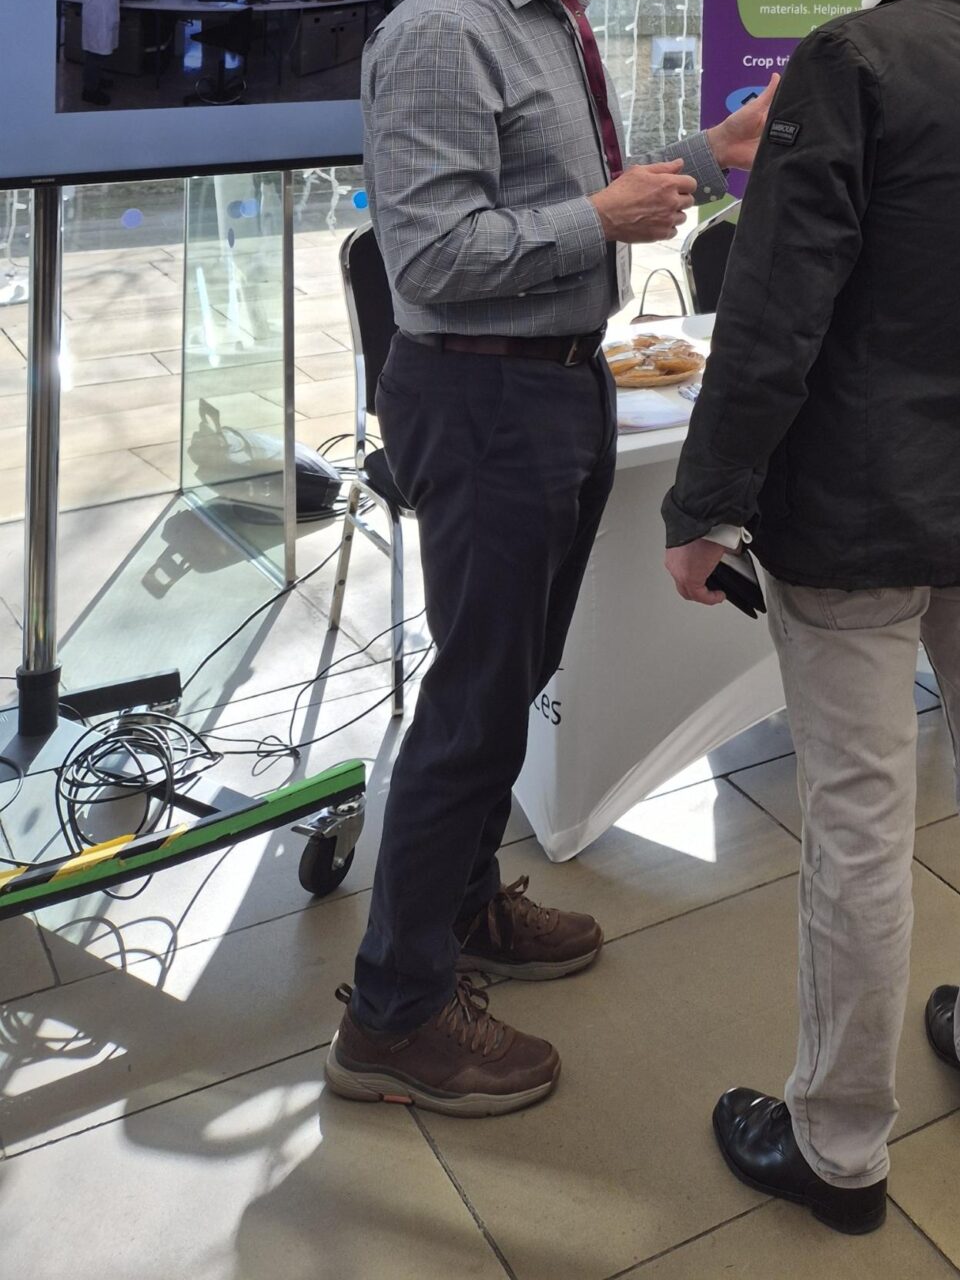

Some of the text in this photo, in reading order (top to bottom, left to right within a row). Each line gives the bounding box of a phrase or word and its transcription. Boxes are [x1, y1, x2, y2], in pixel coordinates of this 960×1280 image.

[760, 4, 811, 14] materials.
[813, 4, 852, 16] Helping
[743, 55, 790, 69] Crop tri
